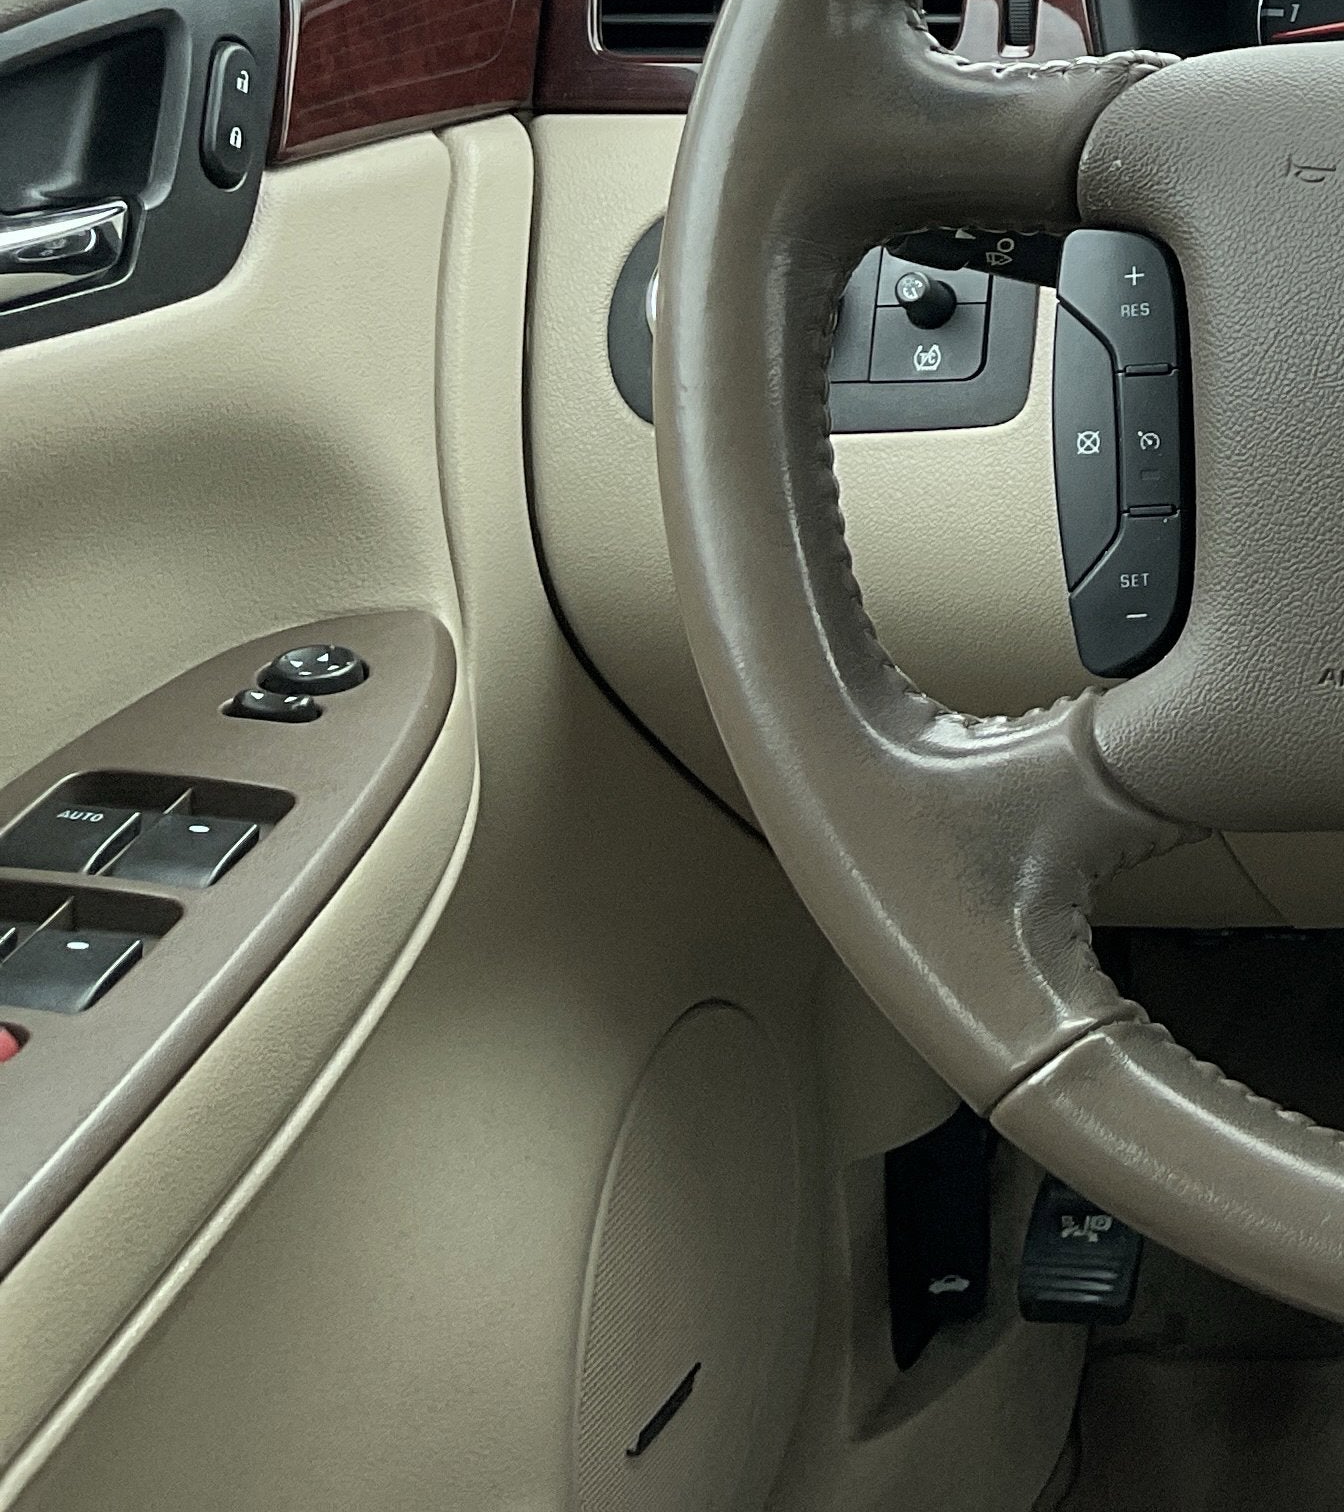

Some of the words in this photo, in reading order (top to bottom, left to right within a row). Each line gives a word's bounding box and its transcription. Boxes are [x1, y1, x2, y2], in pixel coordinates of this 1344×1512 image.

[1289, 3, 1301, 23] 1
[1120, 302, 1151, 317] RES
[1119, 572, 1150, 588] SET
[56, 809, 104, 823] AUTO
